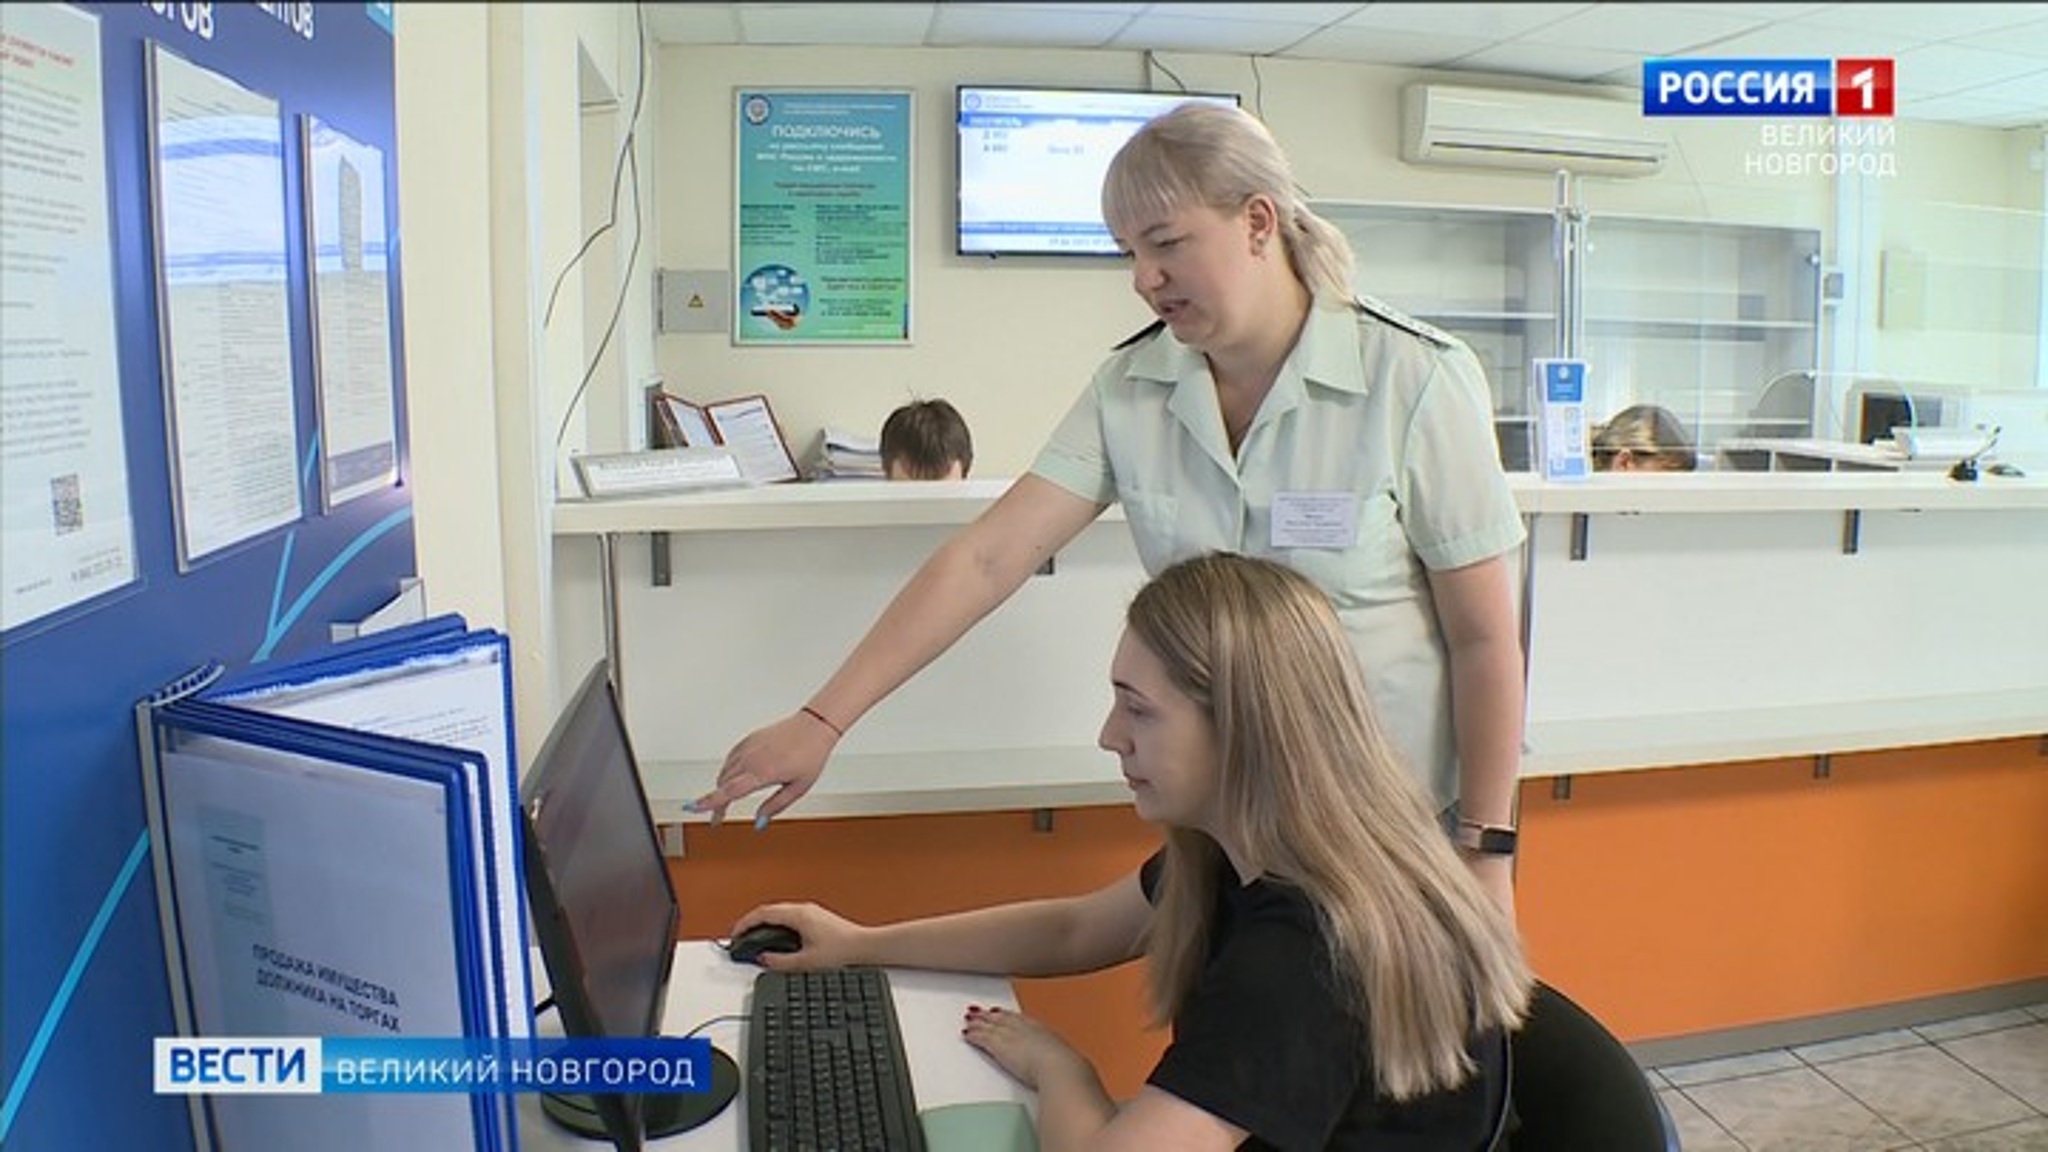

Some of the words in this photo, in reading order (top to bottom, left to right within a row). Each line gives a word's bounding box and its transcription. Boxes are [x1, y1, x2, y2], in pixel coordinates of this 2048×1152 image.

[772, 125, 882, 139] ПОДКЛЮЧИСЬ
[252, 943, 315, 977] ПРОДАЖА
[318, 965, 399, 1008] ИМУЩЕСТВА
[256, 968, 326, 1004] ДОЛЖНИКА
[330, 996, 347, 1011] НА
[349, 1000, 401, 1033] ТОРГАХ
